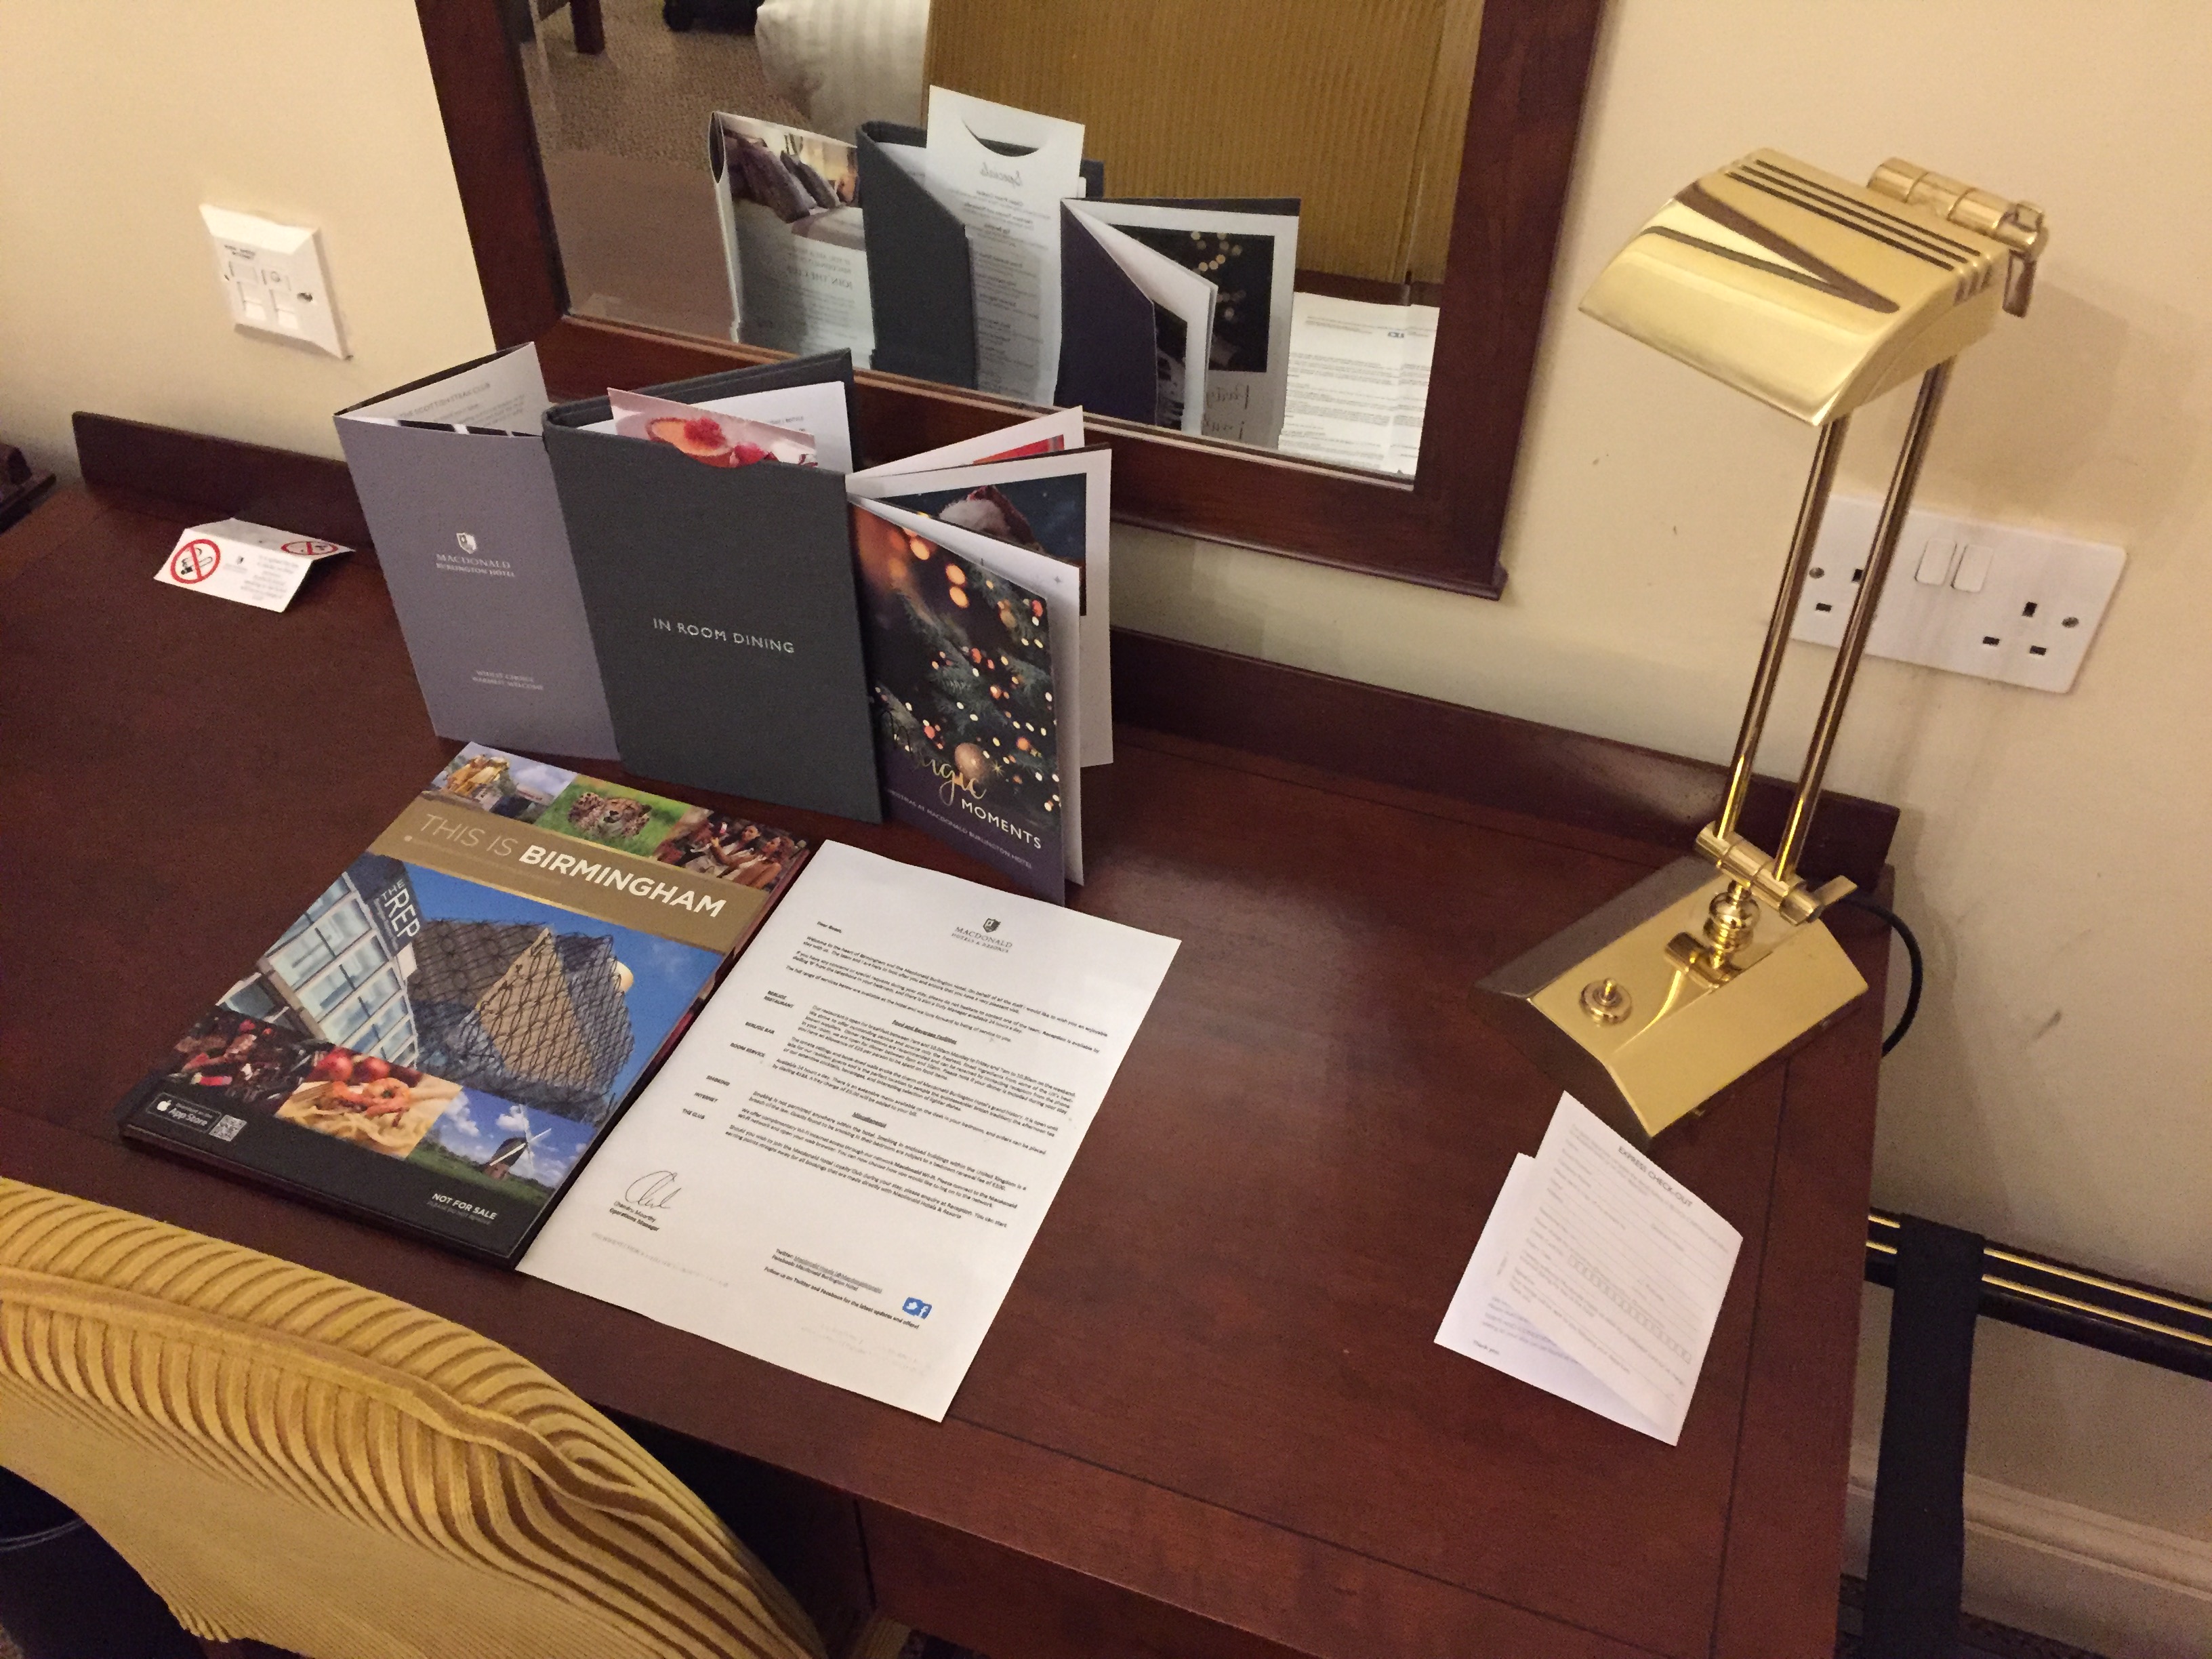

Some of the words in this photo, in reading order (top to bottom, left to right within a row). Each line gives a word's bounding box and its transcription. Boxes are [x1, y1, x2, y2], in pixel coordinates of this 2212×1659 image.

[436, 554, 511, 569] MACDONALD
[436, 562, 488, 575] BURLINGTON
[489, 569, 515, 577] HOTEL
[653, 618, 671, 632] IN
[677, 622, 726, 641] ROOM
[733, 632, 795, 653] DINING
[961, 798, 1042, 849] MOMENTS
[420, 814, 487, 846] THIS
[487, 835, 518, 857] IS
[519, 844, 727, 918] BIRMINGHAM
[381, 879, 405, 901] THE
[384, 888, 420, 937] REP
[955, 926, 1012, 947] MACDONALD
[169, 1107, 187, 1120] App
[186, 1113, 208, 1126] Store
[1618, 1146, 1647, 1172] EXPRESS
[432, 1193, 453, 1204] NOT
[452, 1200, 473, 1212] FOR
[472, 1206, 498, 1220] SALE
